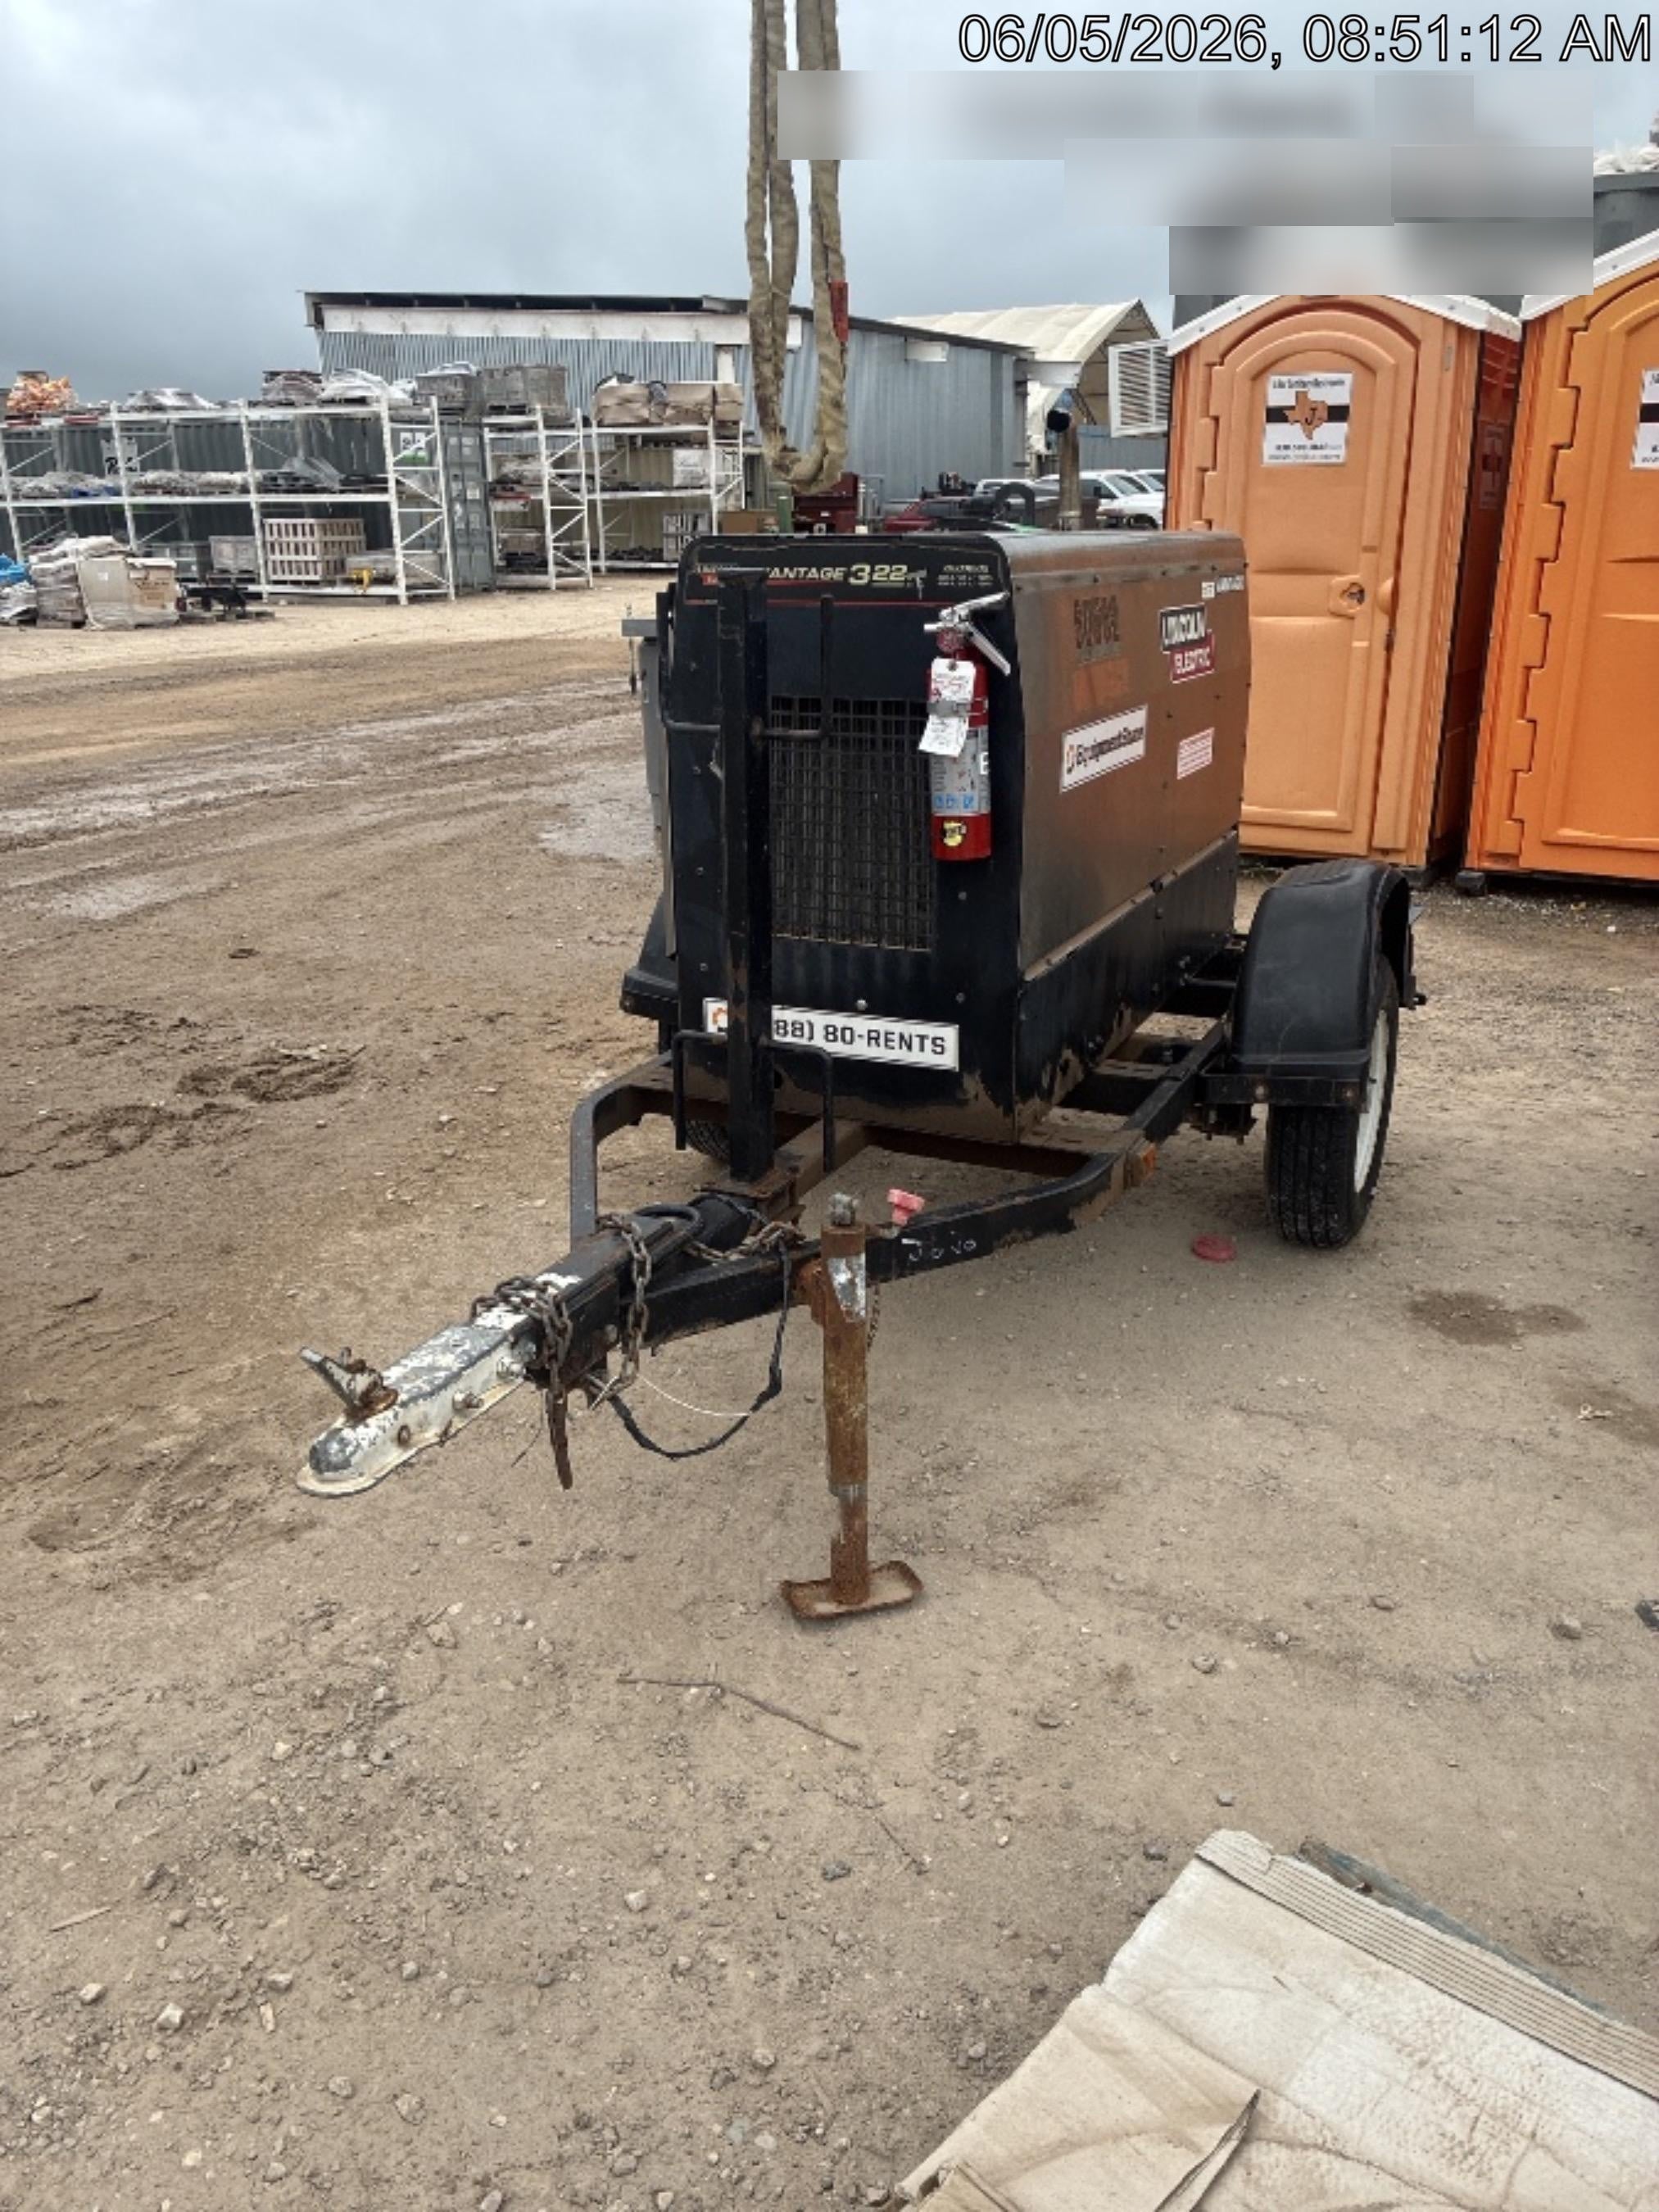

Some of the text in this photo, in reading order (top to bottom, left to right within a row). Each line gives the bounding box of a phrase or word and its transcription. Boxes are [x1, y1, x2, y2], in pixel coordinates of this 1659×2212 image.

[766, 562, 909, 586] ANTAGE 322
[775, 1019, 945, 1055] 88) 80-RENTS
